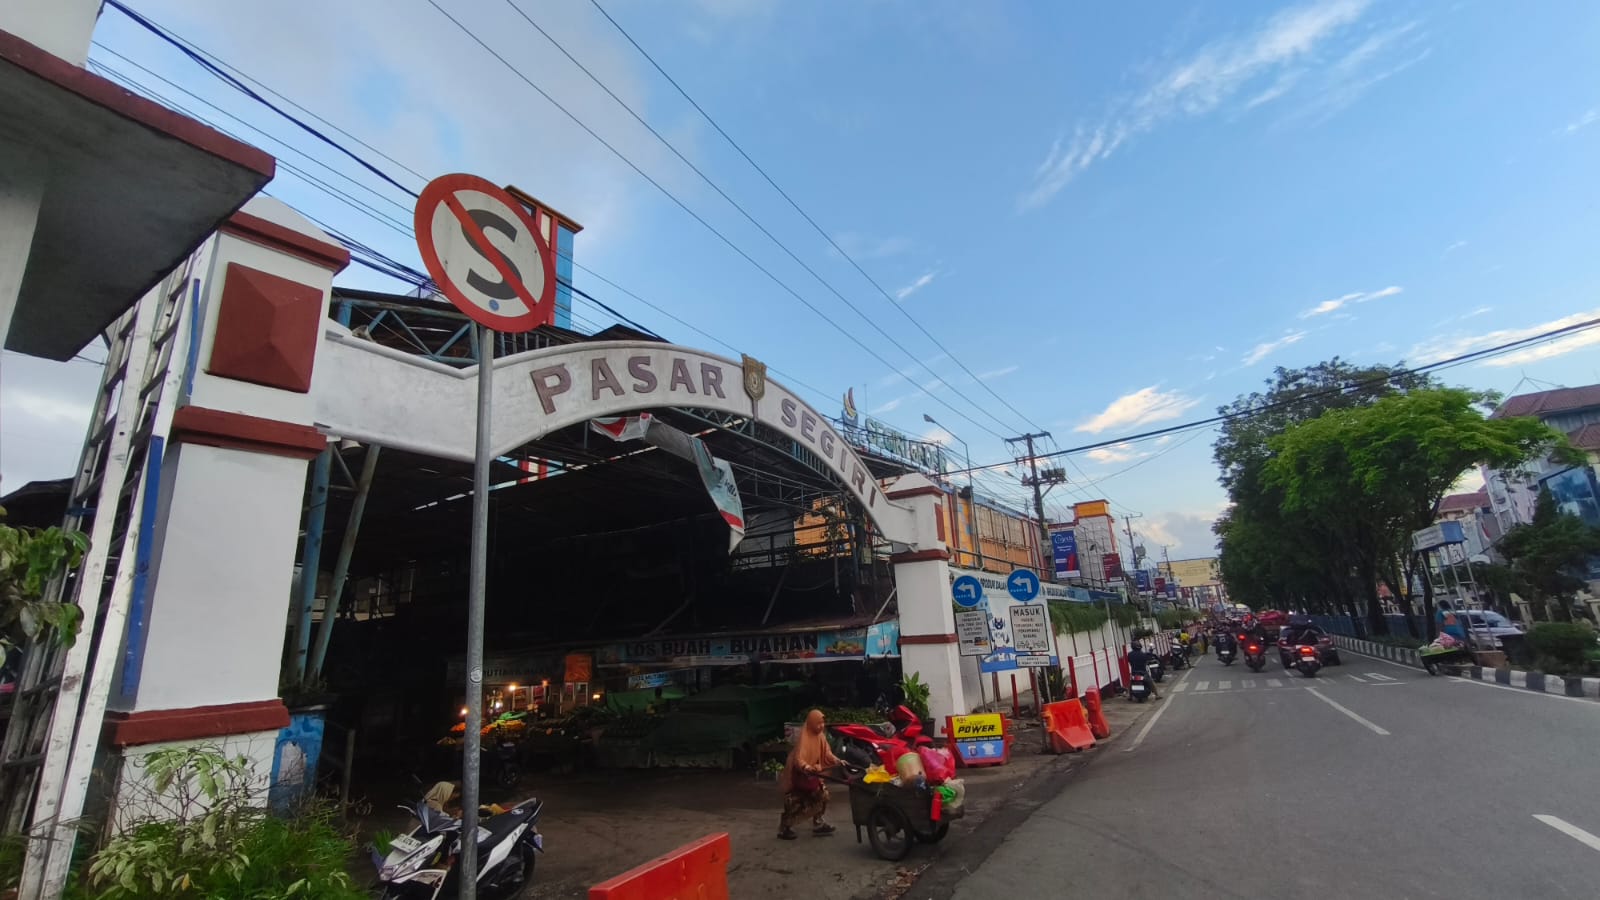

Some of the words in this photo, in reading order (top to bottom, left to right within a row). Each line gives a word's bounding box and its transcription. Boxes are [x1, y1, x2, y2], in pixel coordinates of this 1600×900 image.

[461, 209, 522, 300] S
[530, 355, 726, 415] PASAR
[781, 397, 876, 509] SEGIRI
[1013, 607, 1041, 617] MASUK
[626, 642, 656, 657] LOS
[662, 640, 711, 656] BUAH
[730, 634, 818, 653] BUAHAN
[958, 724, 996, 734] POWER
